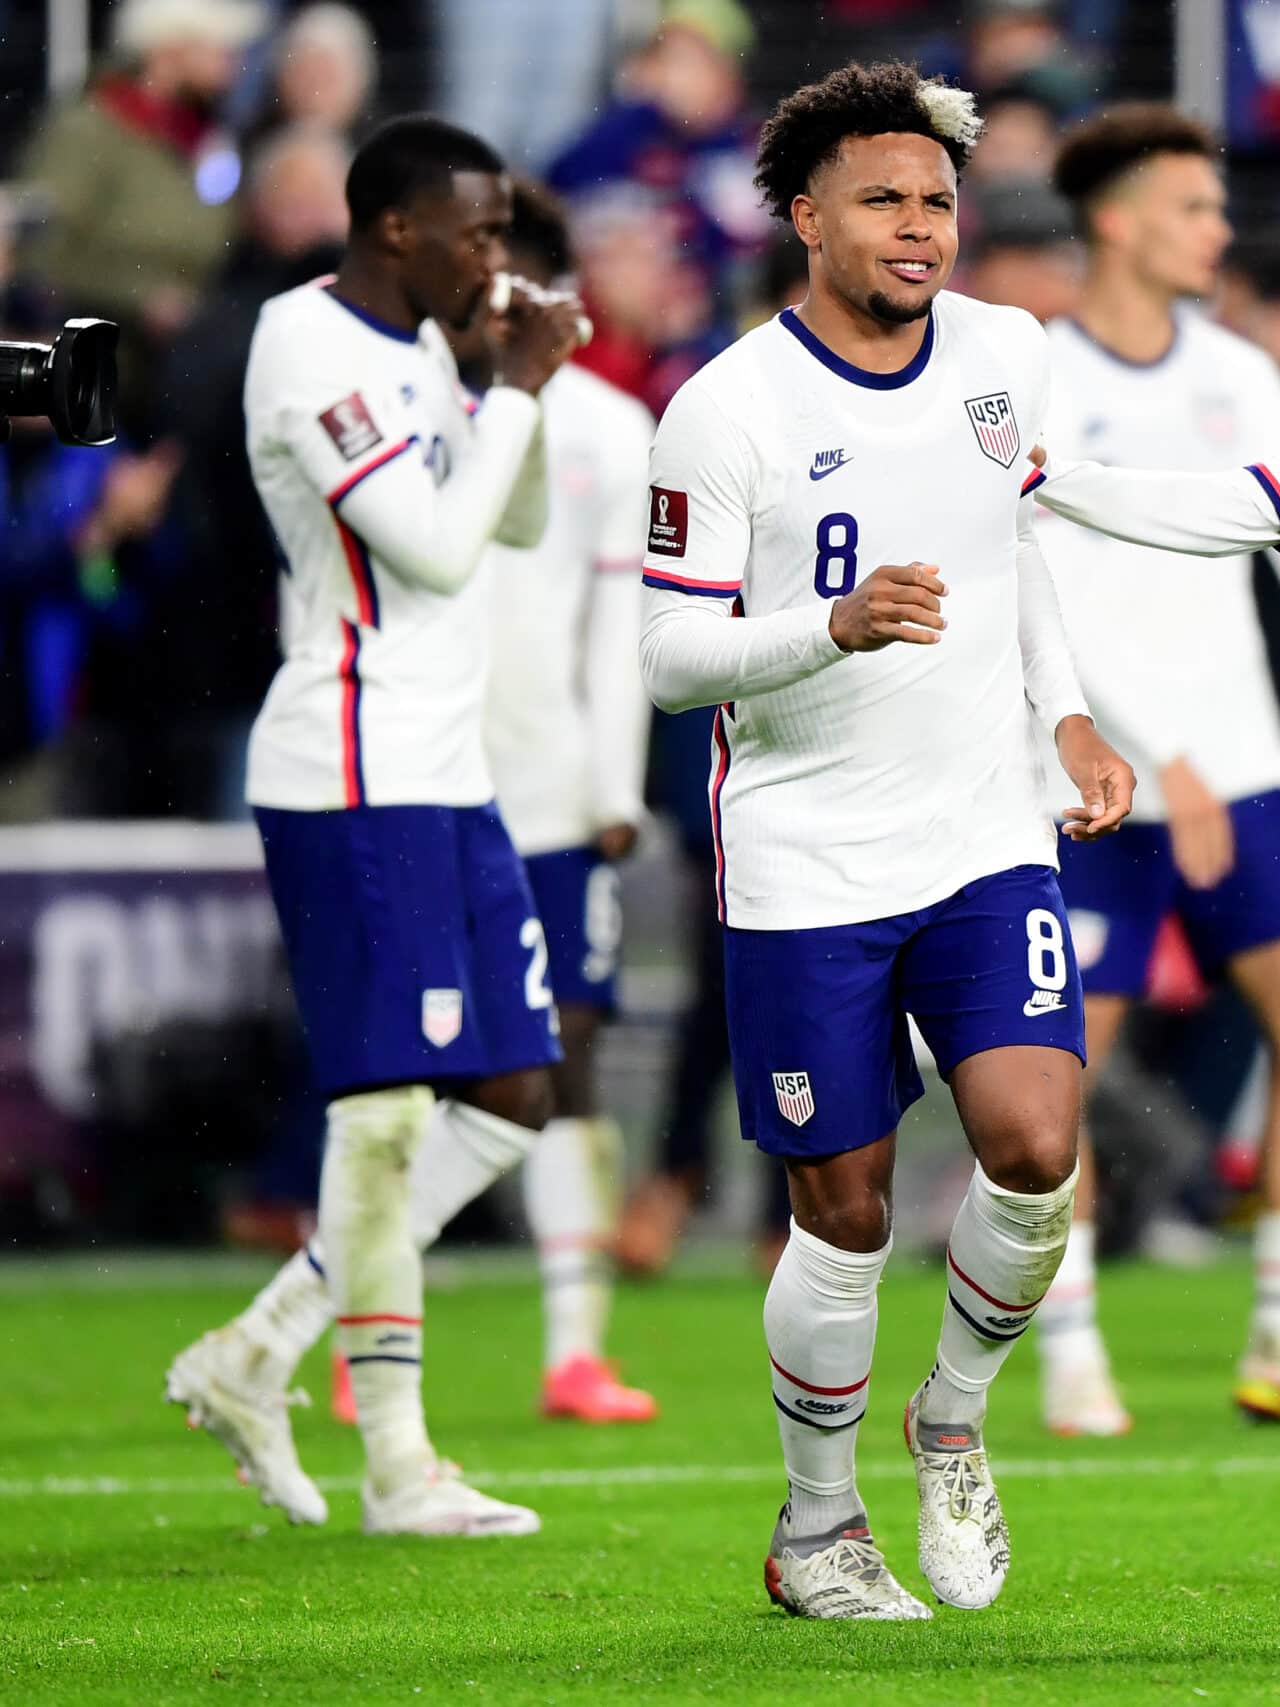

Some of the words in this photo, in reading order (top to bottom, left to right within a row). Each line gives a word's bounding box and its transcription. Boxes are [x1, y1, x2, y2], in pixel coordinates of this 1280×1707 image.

[971, 398, 1009, 426] USA
[815, 448, 845, 469] NIKE
[814, 512, 858, 600] 8
[519, 917, 555, 1010] 2
[1026, 908, 1067, 991] 8
[1030, 990, 1062, 1007] NIKE
[775, 1075, 807, 1095] USA
